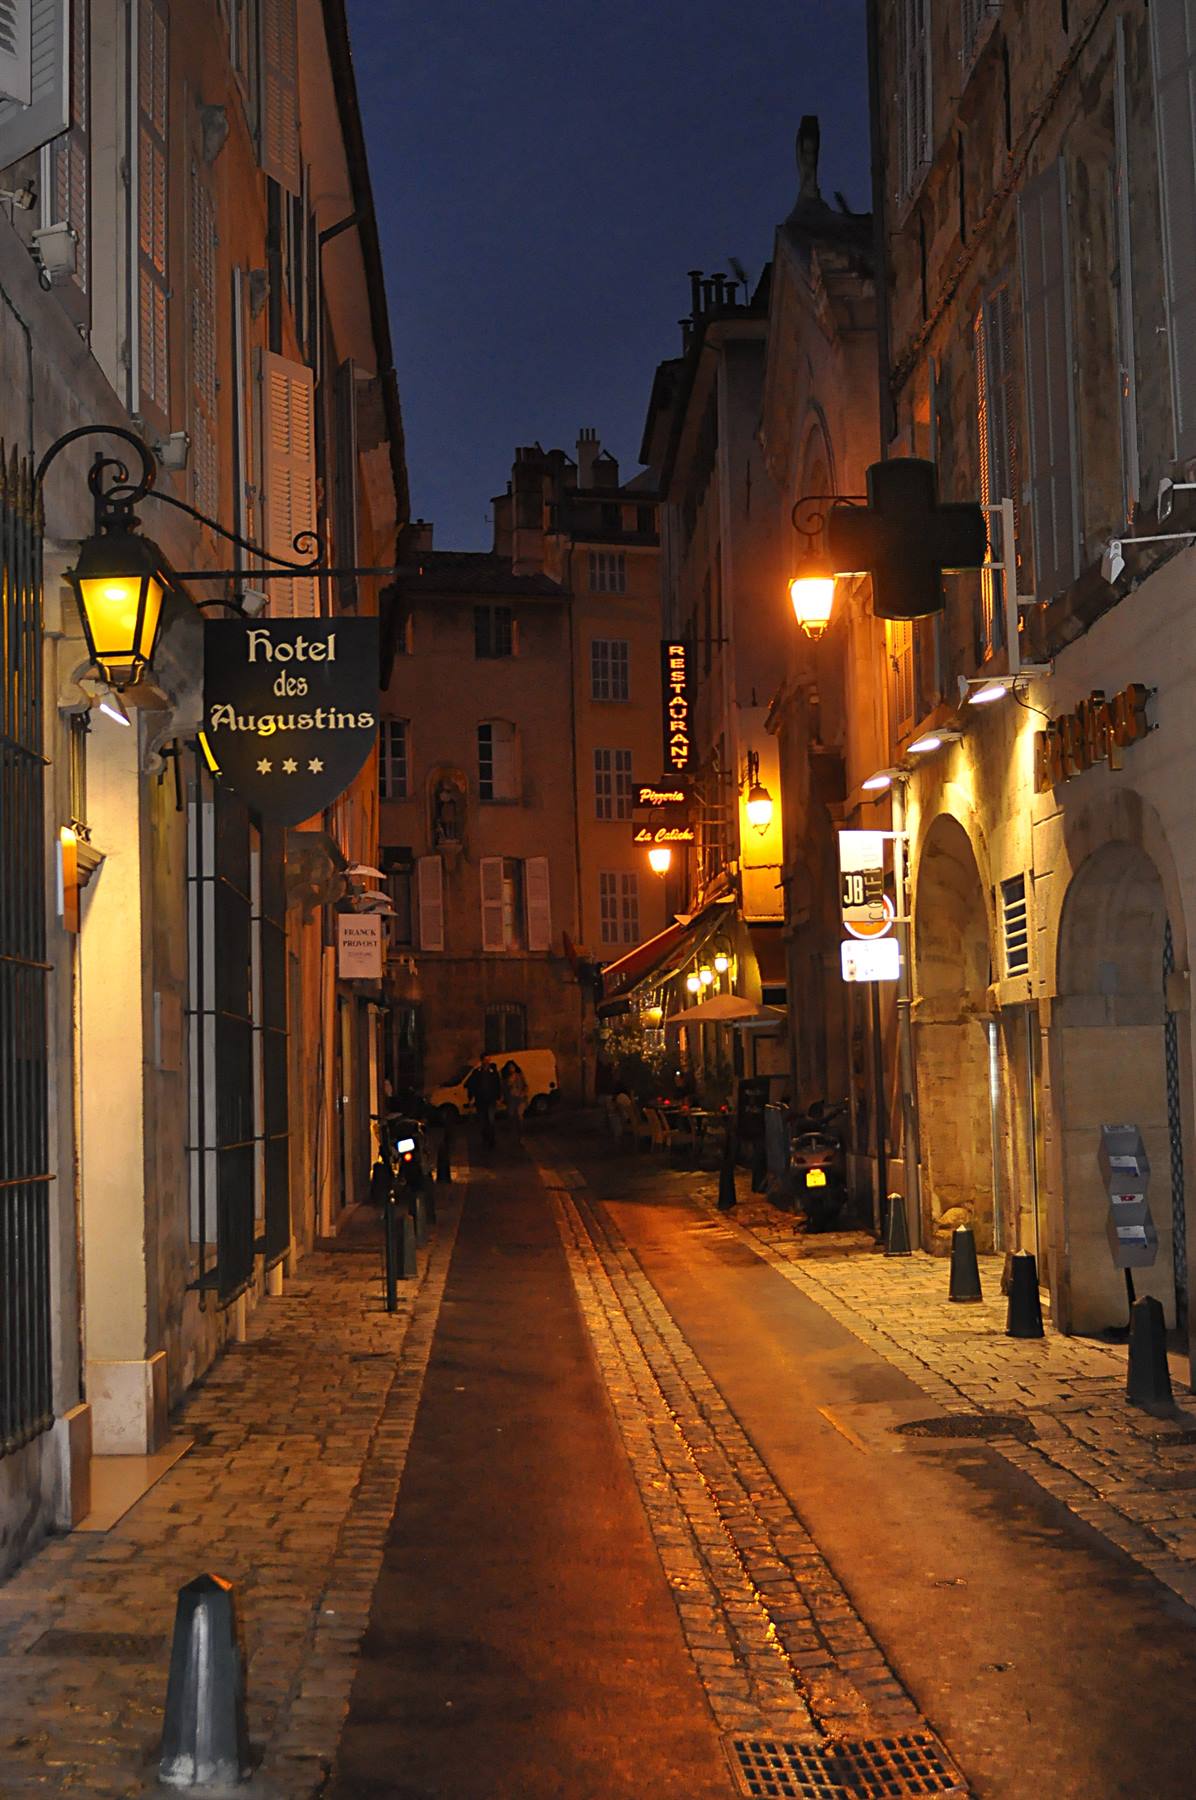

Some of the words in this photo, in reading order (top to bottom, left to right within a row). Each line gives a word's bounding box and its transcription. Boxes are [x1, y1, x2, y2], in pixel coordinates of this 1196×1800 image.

[273, 669, 308, 697] des
[210, 703, 375, 736] Augustins
[669, 645, 689, 769] RESTAURANT
[639, 788, 684, 804] Pizzeria
[634, 828, 653, 842] La
[843, 875, 864, 905] JB
[344, 928, 376, 937] FRANCK
